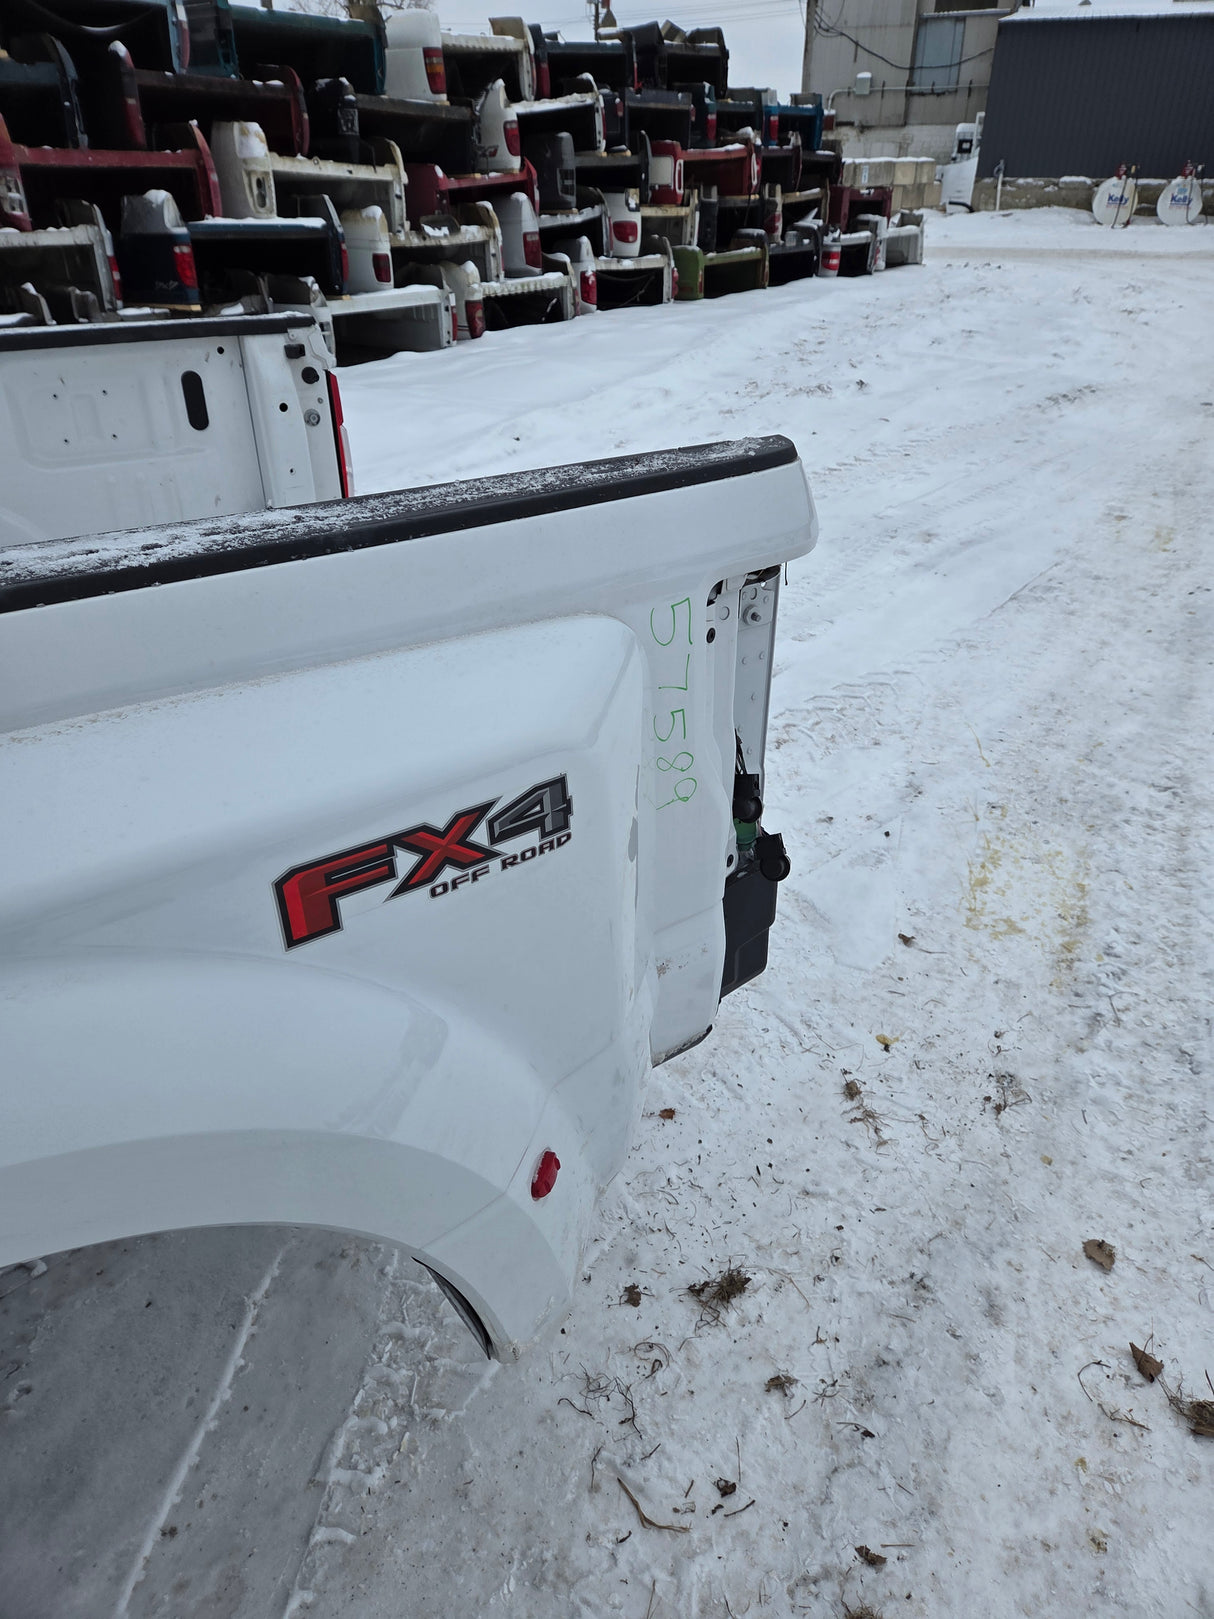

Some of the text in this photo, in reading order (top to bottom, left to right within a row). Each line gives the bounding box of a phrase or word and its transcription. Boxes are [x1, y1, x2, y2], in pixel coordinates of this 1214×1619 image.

[1170, 193, 1193, 206] Kelly
[272, 773, 573, 952] FX4
[429, 832, 572, 900] OFF ROAD
